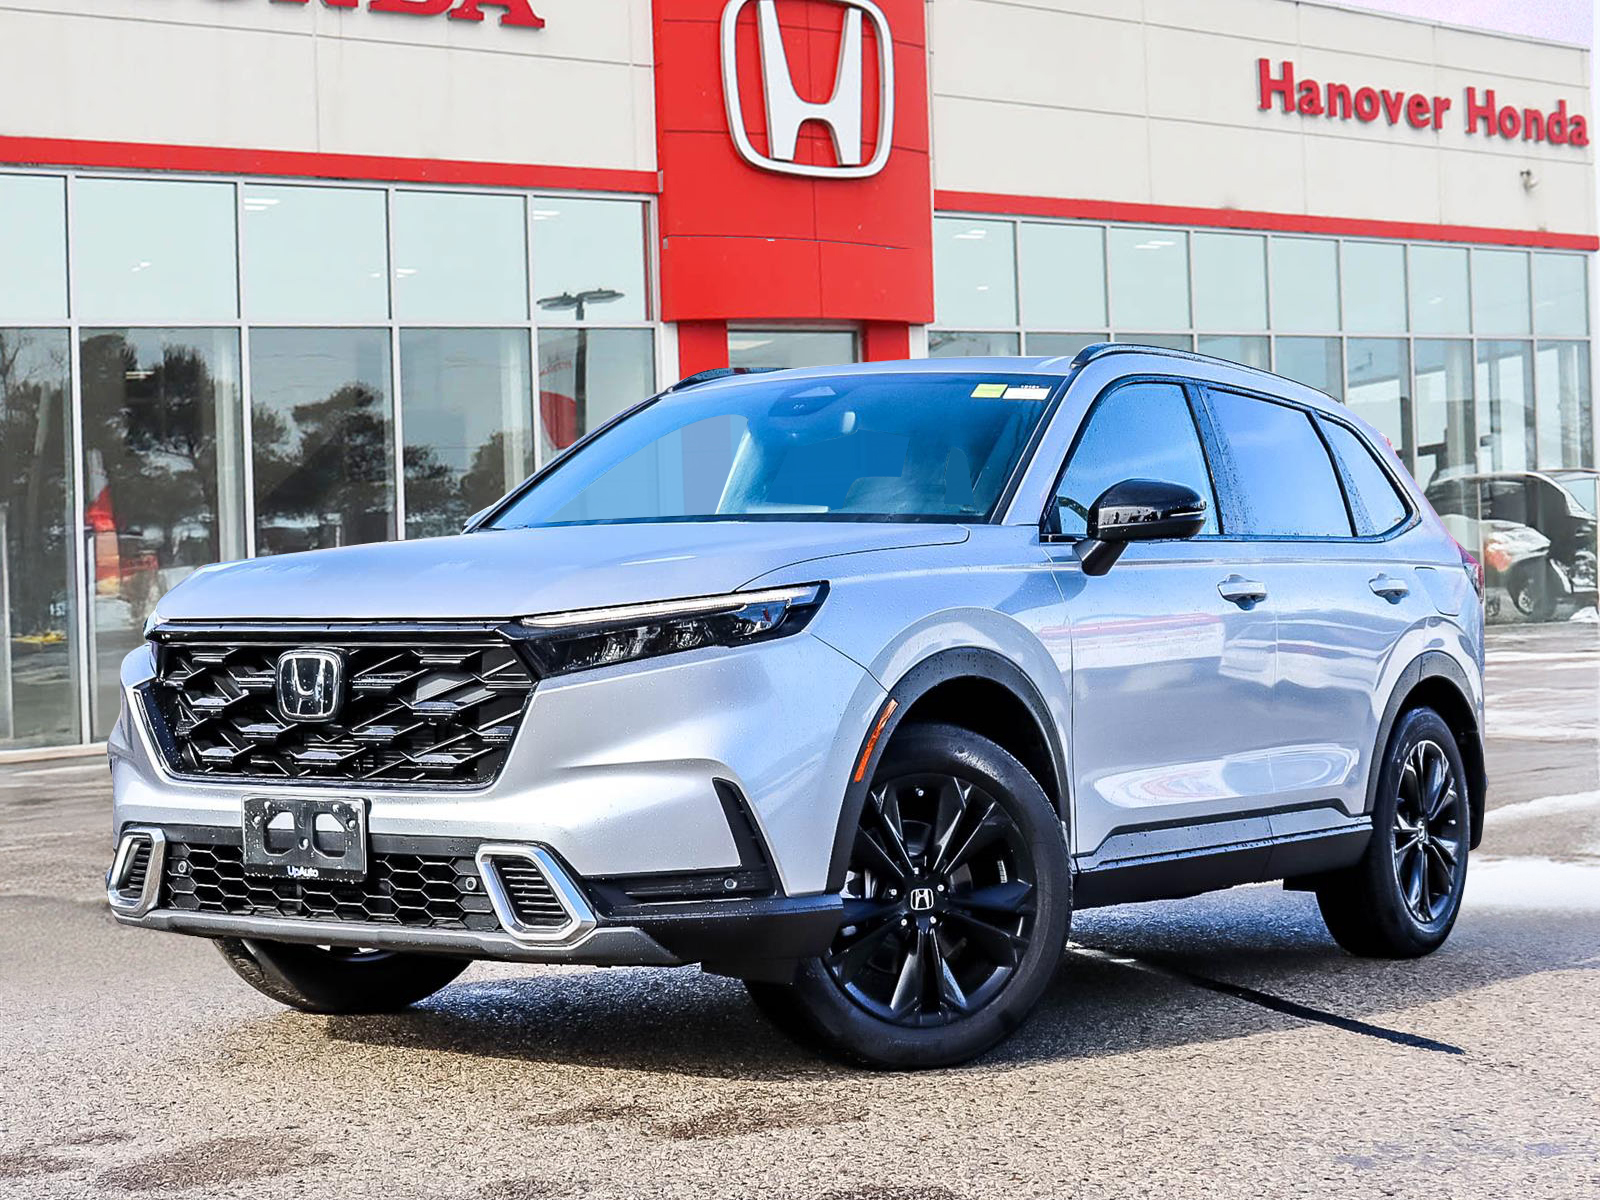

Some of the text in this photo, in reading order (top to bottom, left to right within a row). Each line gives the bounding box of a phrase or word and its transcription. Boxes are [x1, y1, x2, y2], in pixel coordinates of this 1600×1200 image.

[1257, 58, 1589, 147] Hanover Honda
[286, 865, 319, 878] UpAuto
